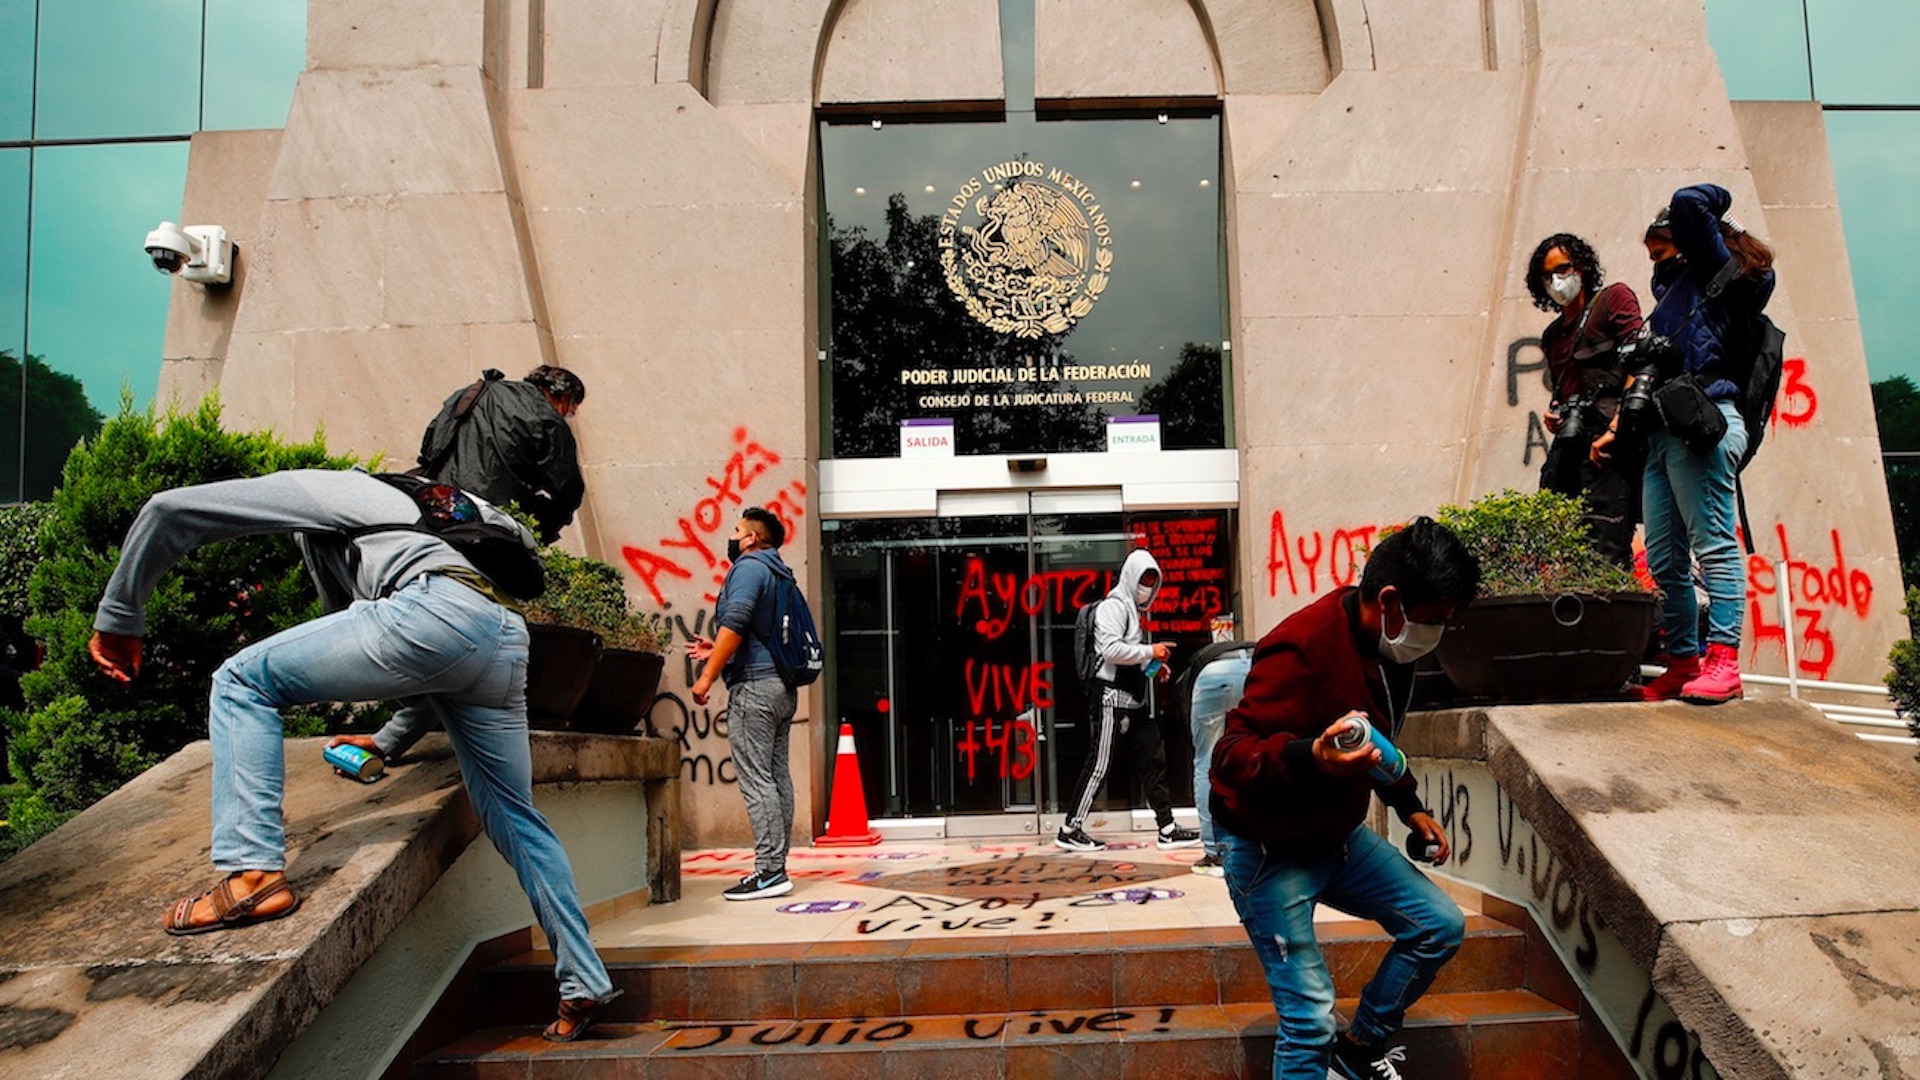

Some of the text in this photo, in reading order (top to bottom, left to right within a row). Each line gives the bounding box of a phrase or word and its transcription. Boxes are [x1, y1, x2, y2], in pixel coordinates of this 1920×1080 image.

[938, 160, 1112, 247] ESTADOS UNIDOS MEXICANOS
[901, 360, 1151, 385] PODER JUDICIAL DE LA FEDERACIÓN
[919, 390, 1134, 408] CONSEJO DE LA JUDICATURA FEDERAL
[1769, 357, 1817, 440] 3
[906, 436, 948, 448] SALIDA
[1112, 434, 1156, 445] ENTRADA
[1267, 510, 1408, 598] AYOT
[965, 657, 1054, 715] VIVE
[664, 1016, 914, 1050] Julio
